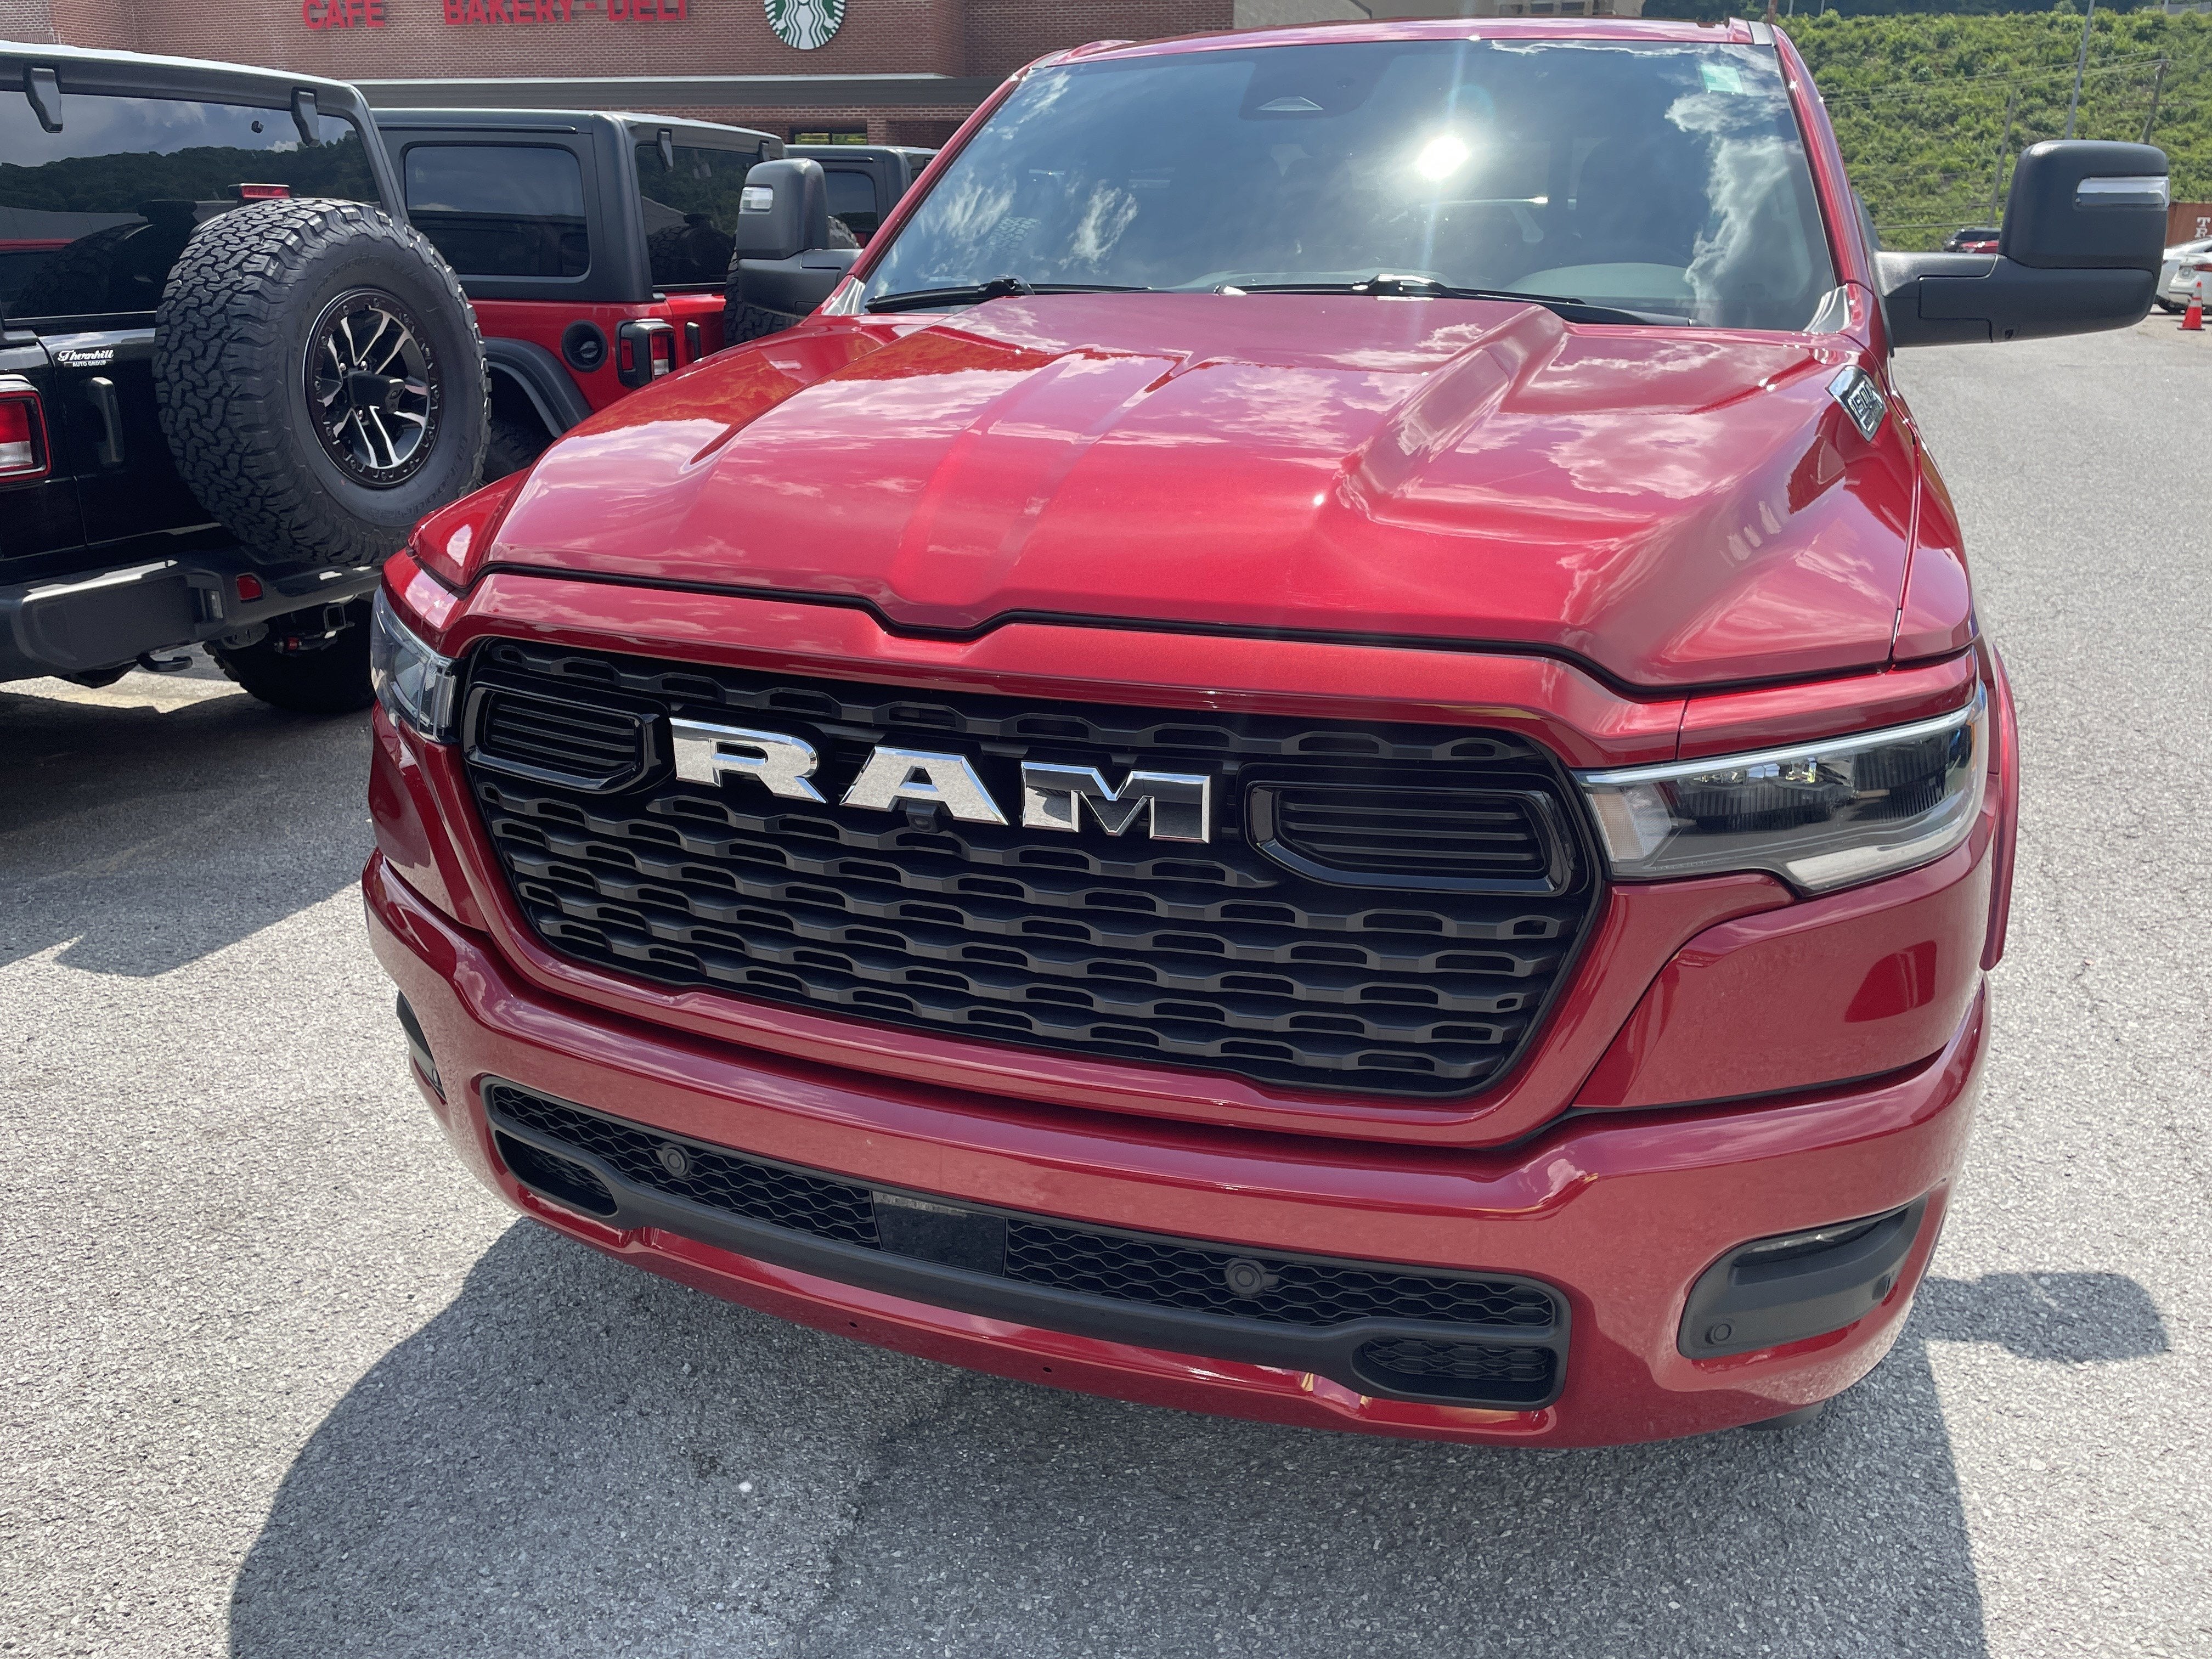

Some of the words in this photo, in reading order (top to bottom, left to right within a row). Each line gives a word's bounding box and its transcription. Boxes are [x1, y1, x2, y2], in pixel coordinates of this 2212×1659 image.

[302, 0, 386, 29] CAFE
[443, 0, 573, 25] BAKERY
[607, 0, 686, 22] DELI
[57, 349, 114, 362] Thornhill
[670, 716, 1211, 844] RAM
